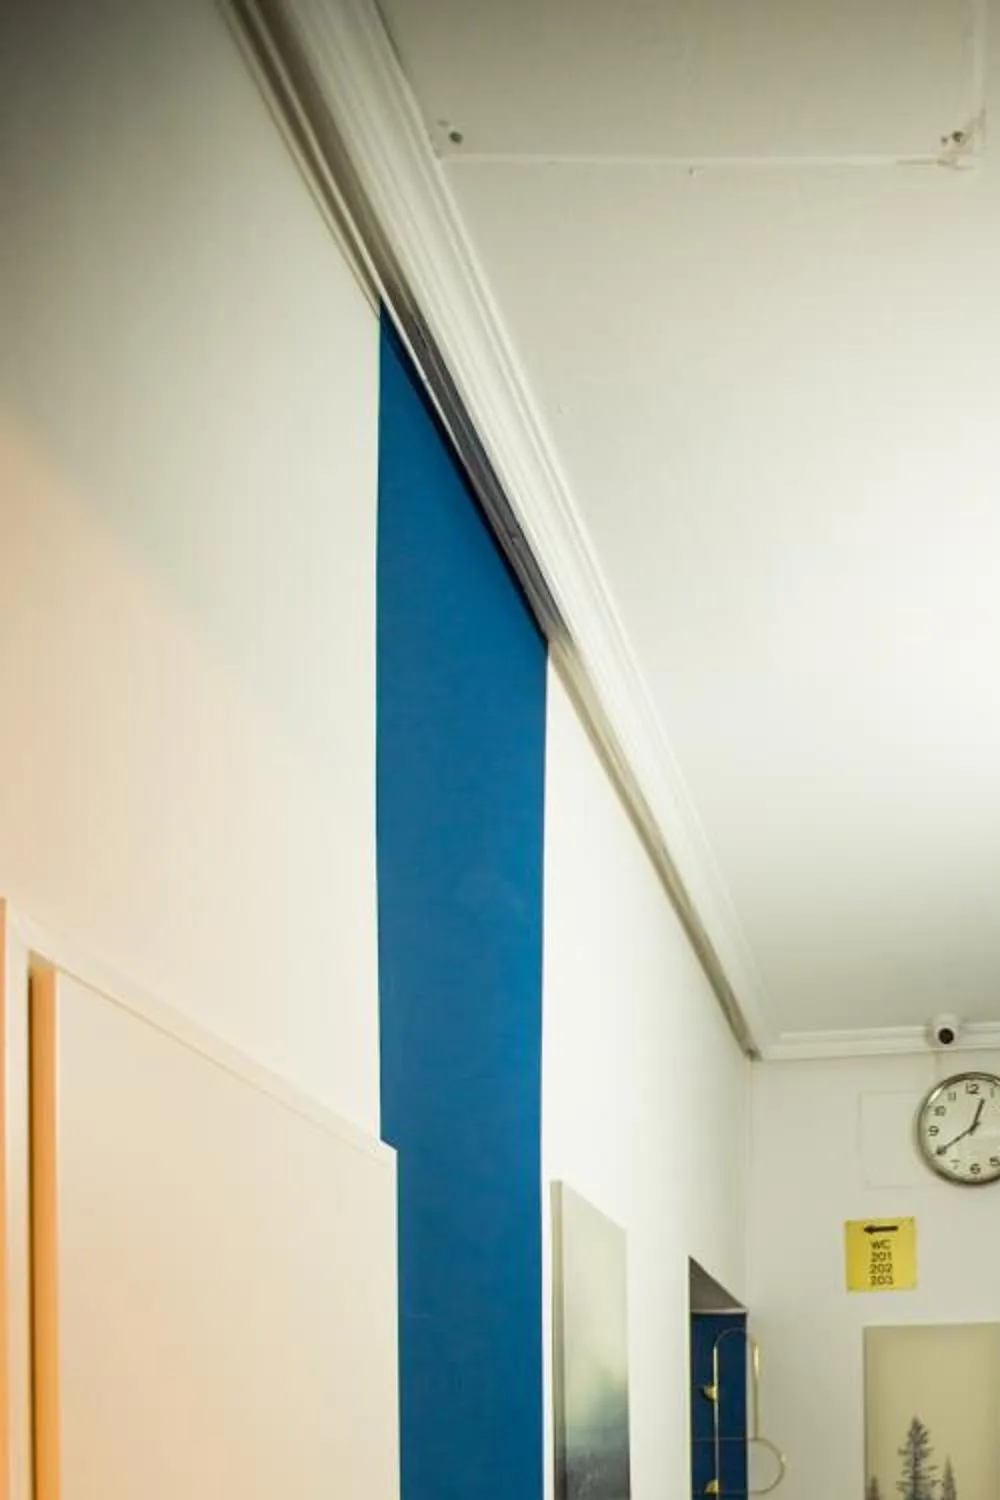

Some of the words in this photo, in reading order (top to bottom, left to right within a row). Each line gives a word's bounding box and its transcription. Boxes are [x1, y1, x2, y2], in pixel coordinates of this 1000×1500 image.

[966, 1083, 980, 1095] 12
[935, 1105, 946, 1117] 10
[928, 1125, 940, 1136] 9
[989, 1156, 1000, 1168] 5
[970, 1163, 981, 1175] 6
[869, 1239, 892, 1250] WC
[871, 1251, 892, 1262] 201
[869, 1263, 893, 1274] 202
[870, 1275, 894, 1286] 203
